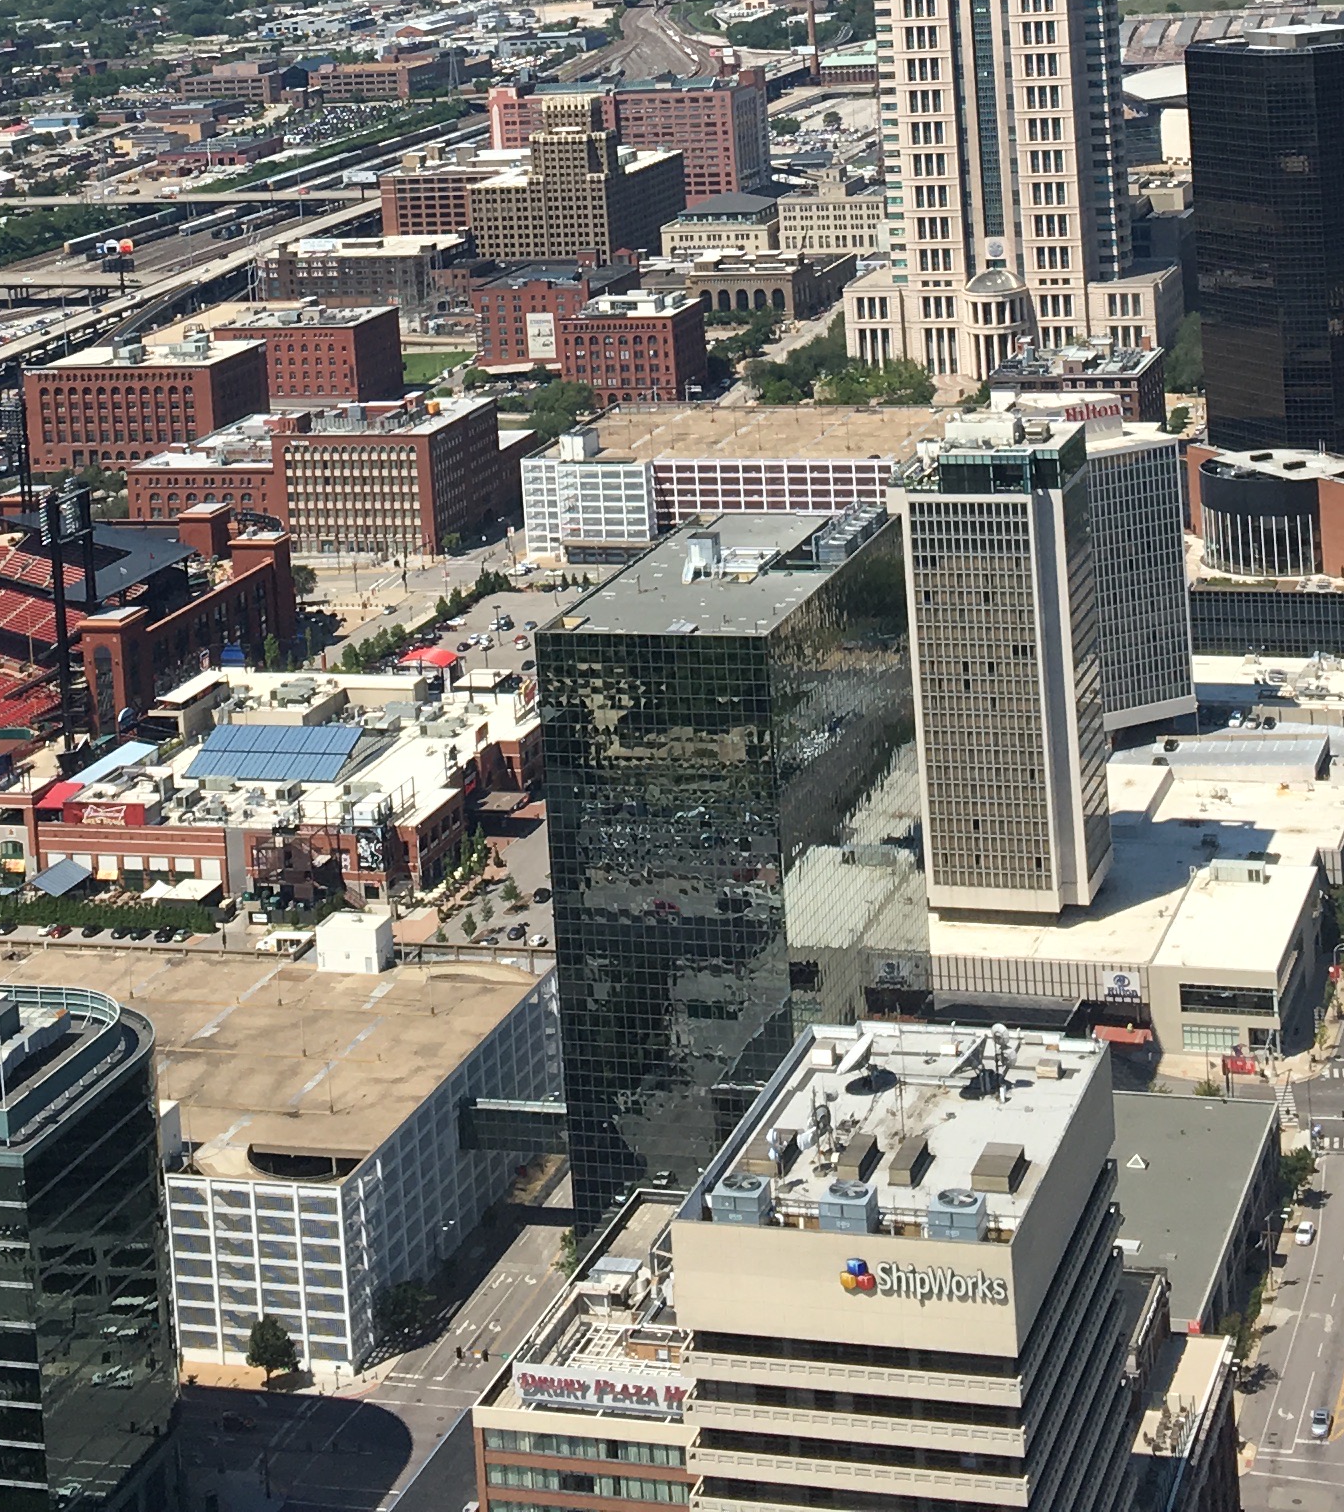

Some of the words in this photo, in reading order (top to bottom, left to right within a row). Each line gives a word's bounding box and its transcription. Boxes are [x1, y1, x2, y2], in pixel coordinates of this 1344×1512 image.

[1064, 403, 1121, 422] Hilton
[876, 1261, 1007, 1301] ShipWorks
[518, 1372, 587, 1395] DRURY
[594, 1379, 658, 1400] PLAZA
